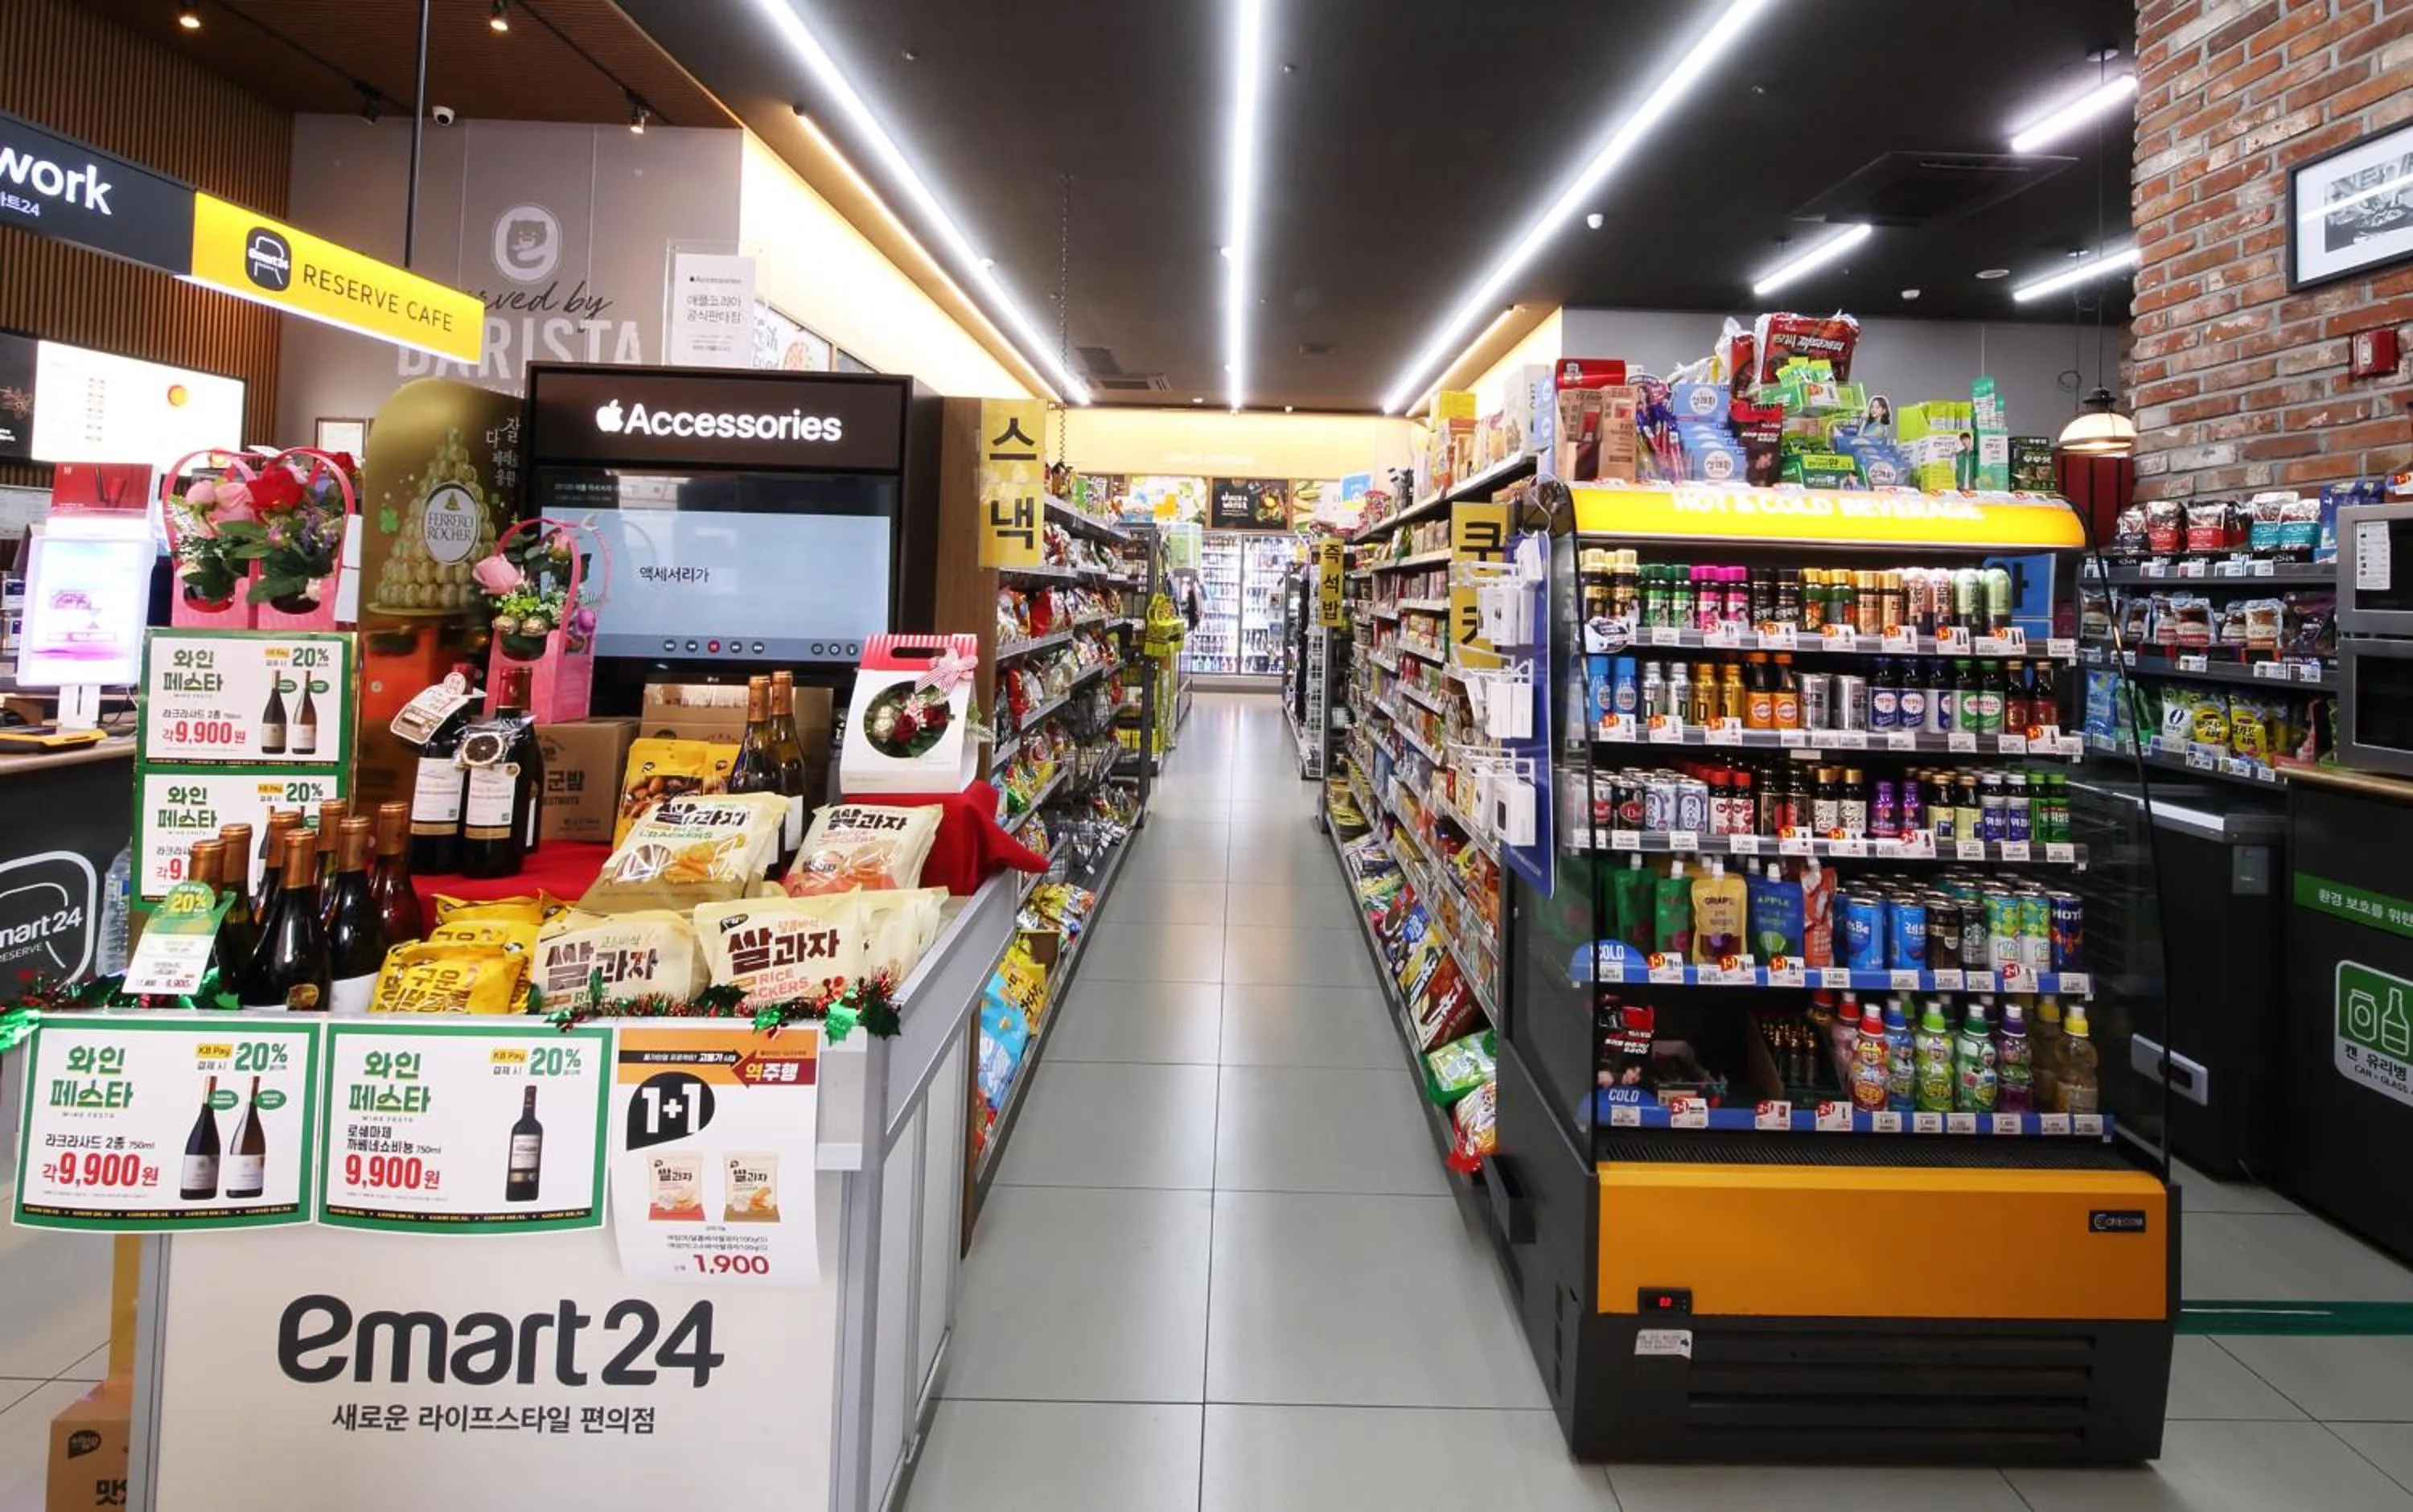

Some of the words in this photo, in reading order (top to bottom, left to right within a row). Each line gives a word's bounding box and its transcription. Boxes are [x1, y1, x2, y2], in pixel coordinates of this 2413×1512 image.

[303, 263, 400, 314] RESERVE
[406, 300, 454, 332] CAFE
[564, 281, 613, 319] by
[624, 404, 842, 442] Accessories
[989, 417, 1038, 550] 스낵
[428, 512, 475, 528] FERRERO
[427, 528, 472, 541] ROCHER
[639, 565, 709, 583] 액세서리가
[1323, 544, 1341, 620] 즉석밥
[173, 649, 214, 668] 와인
[292, 647, 329, 668] 20%
[162, 672, 224, 692] 페스타
[167, 786, 207, 805] 와인
[286, 783, 323, 803] 20%
[157, 809, 217, 828] 페스타
[828, 808, 911, 831] 쌀과자
[2318, 888, 2342, 907] 환경
[2346, 896, 2384, 919] 보호를
[545, 940, 659, 991] 쌀과자
[727, 927, 840, 976] 쌀과자
[758, 968, 794, 986] RICE
[67, 1046, 125, 1074] 와인
[235, 1042, 288, 1071] 20%
[364, 1050, 421, 1079] 와인
[529, 1047, 582, 1076] 20%
[2345, 1043, 2359, 1061] 캔
[2366, 1053, 2407, 1083] 유리병
[746, 1062, 799, 1082] 역주행
[2354, 1064, 2373, 1079] CAN
[2381, 1075, 2408, 1095] GLASS
[50, 1079, 134, 1109] 페스타
[348, 1084, 431, 1113] 페스타
[1609, 1089, 1639, 1103] COLD
[642, 1083, 702, 1134] 1+1
[45, 1133, 101, 1148] 라크라사드
[105, 1136, 125, 1150] 2종
[129, 1141, 155, 1149] 750ml
[417, 1144, 442, 1154] 750ml
[658, 1168, 693, 1181] 쌀과자
[733, 1169, 768, 1183] 쌀과자
[277, 1294, 724, 1388] emart24
[332, 1404, 409, 1432] 새로운
[418, 1405, 571, 1434] 라이프스타일
[580, 1407, 656, 1435] 편의점
